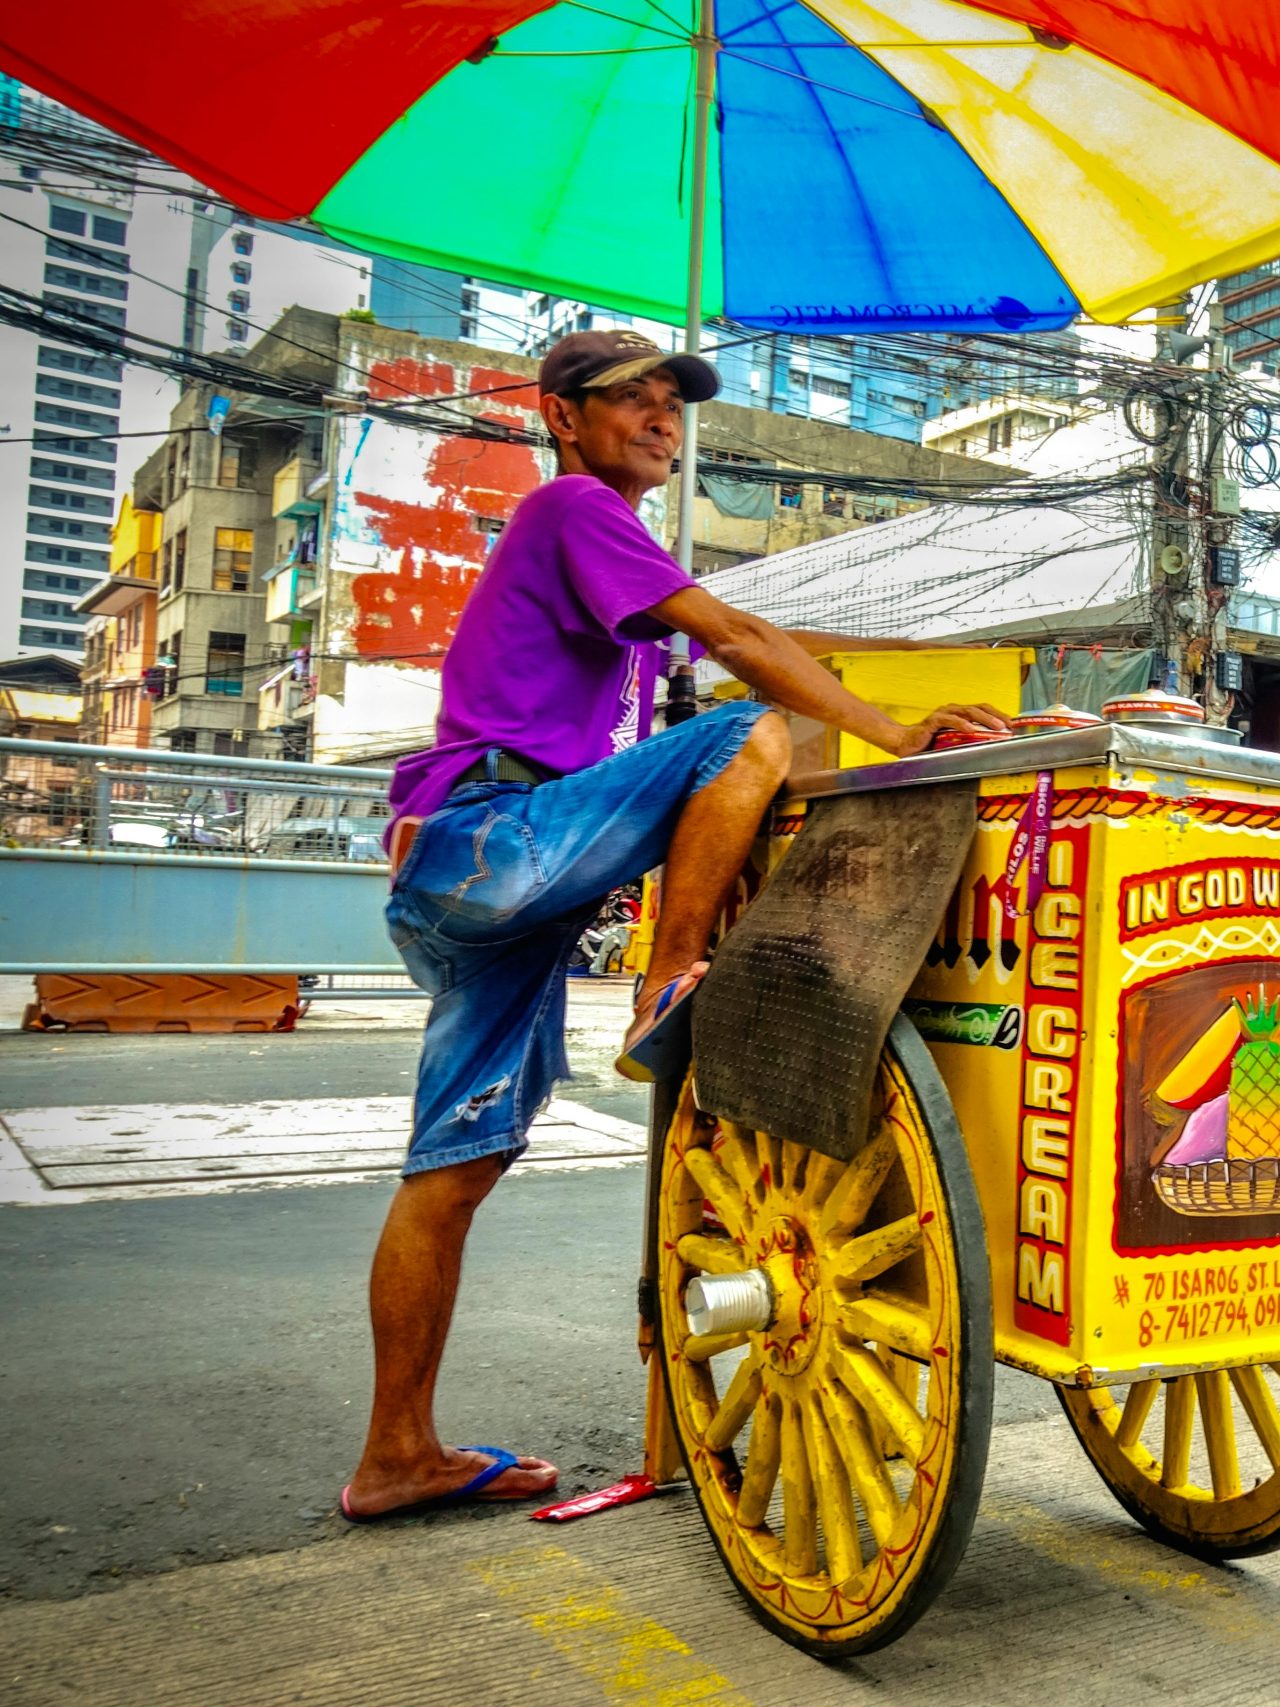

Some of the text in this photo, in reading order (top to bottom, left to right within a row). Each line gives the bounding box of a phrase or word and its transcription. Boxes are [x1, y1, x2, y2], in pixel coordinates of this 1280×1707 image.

[1125, 879, 1169, 932] IN
[1177, 867, 1247, 915] GOD
[1017, 839, 1081, 1316] ICE CREAM
[1144, 1271, 1165, 1302] 70
[1172, 1265, 1238, 1300] ISAROG
